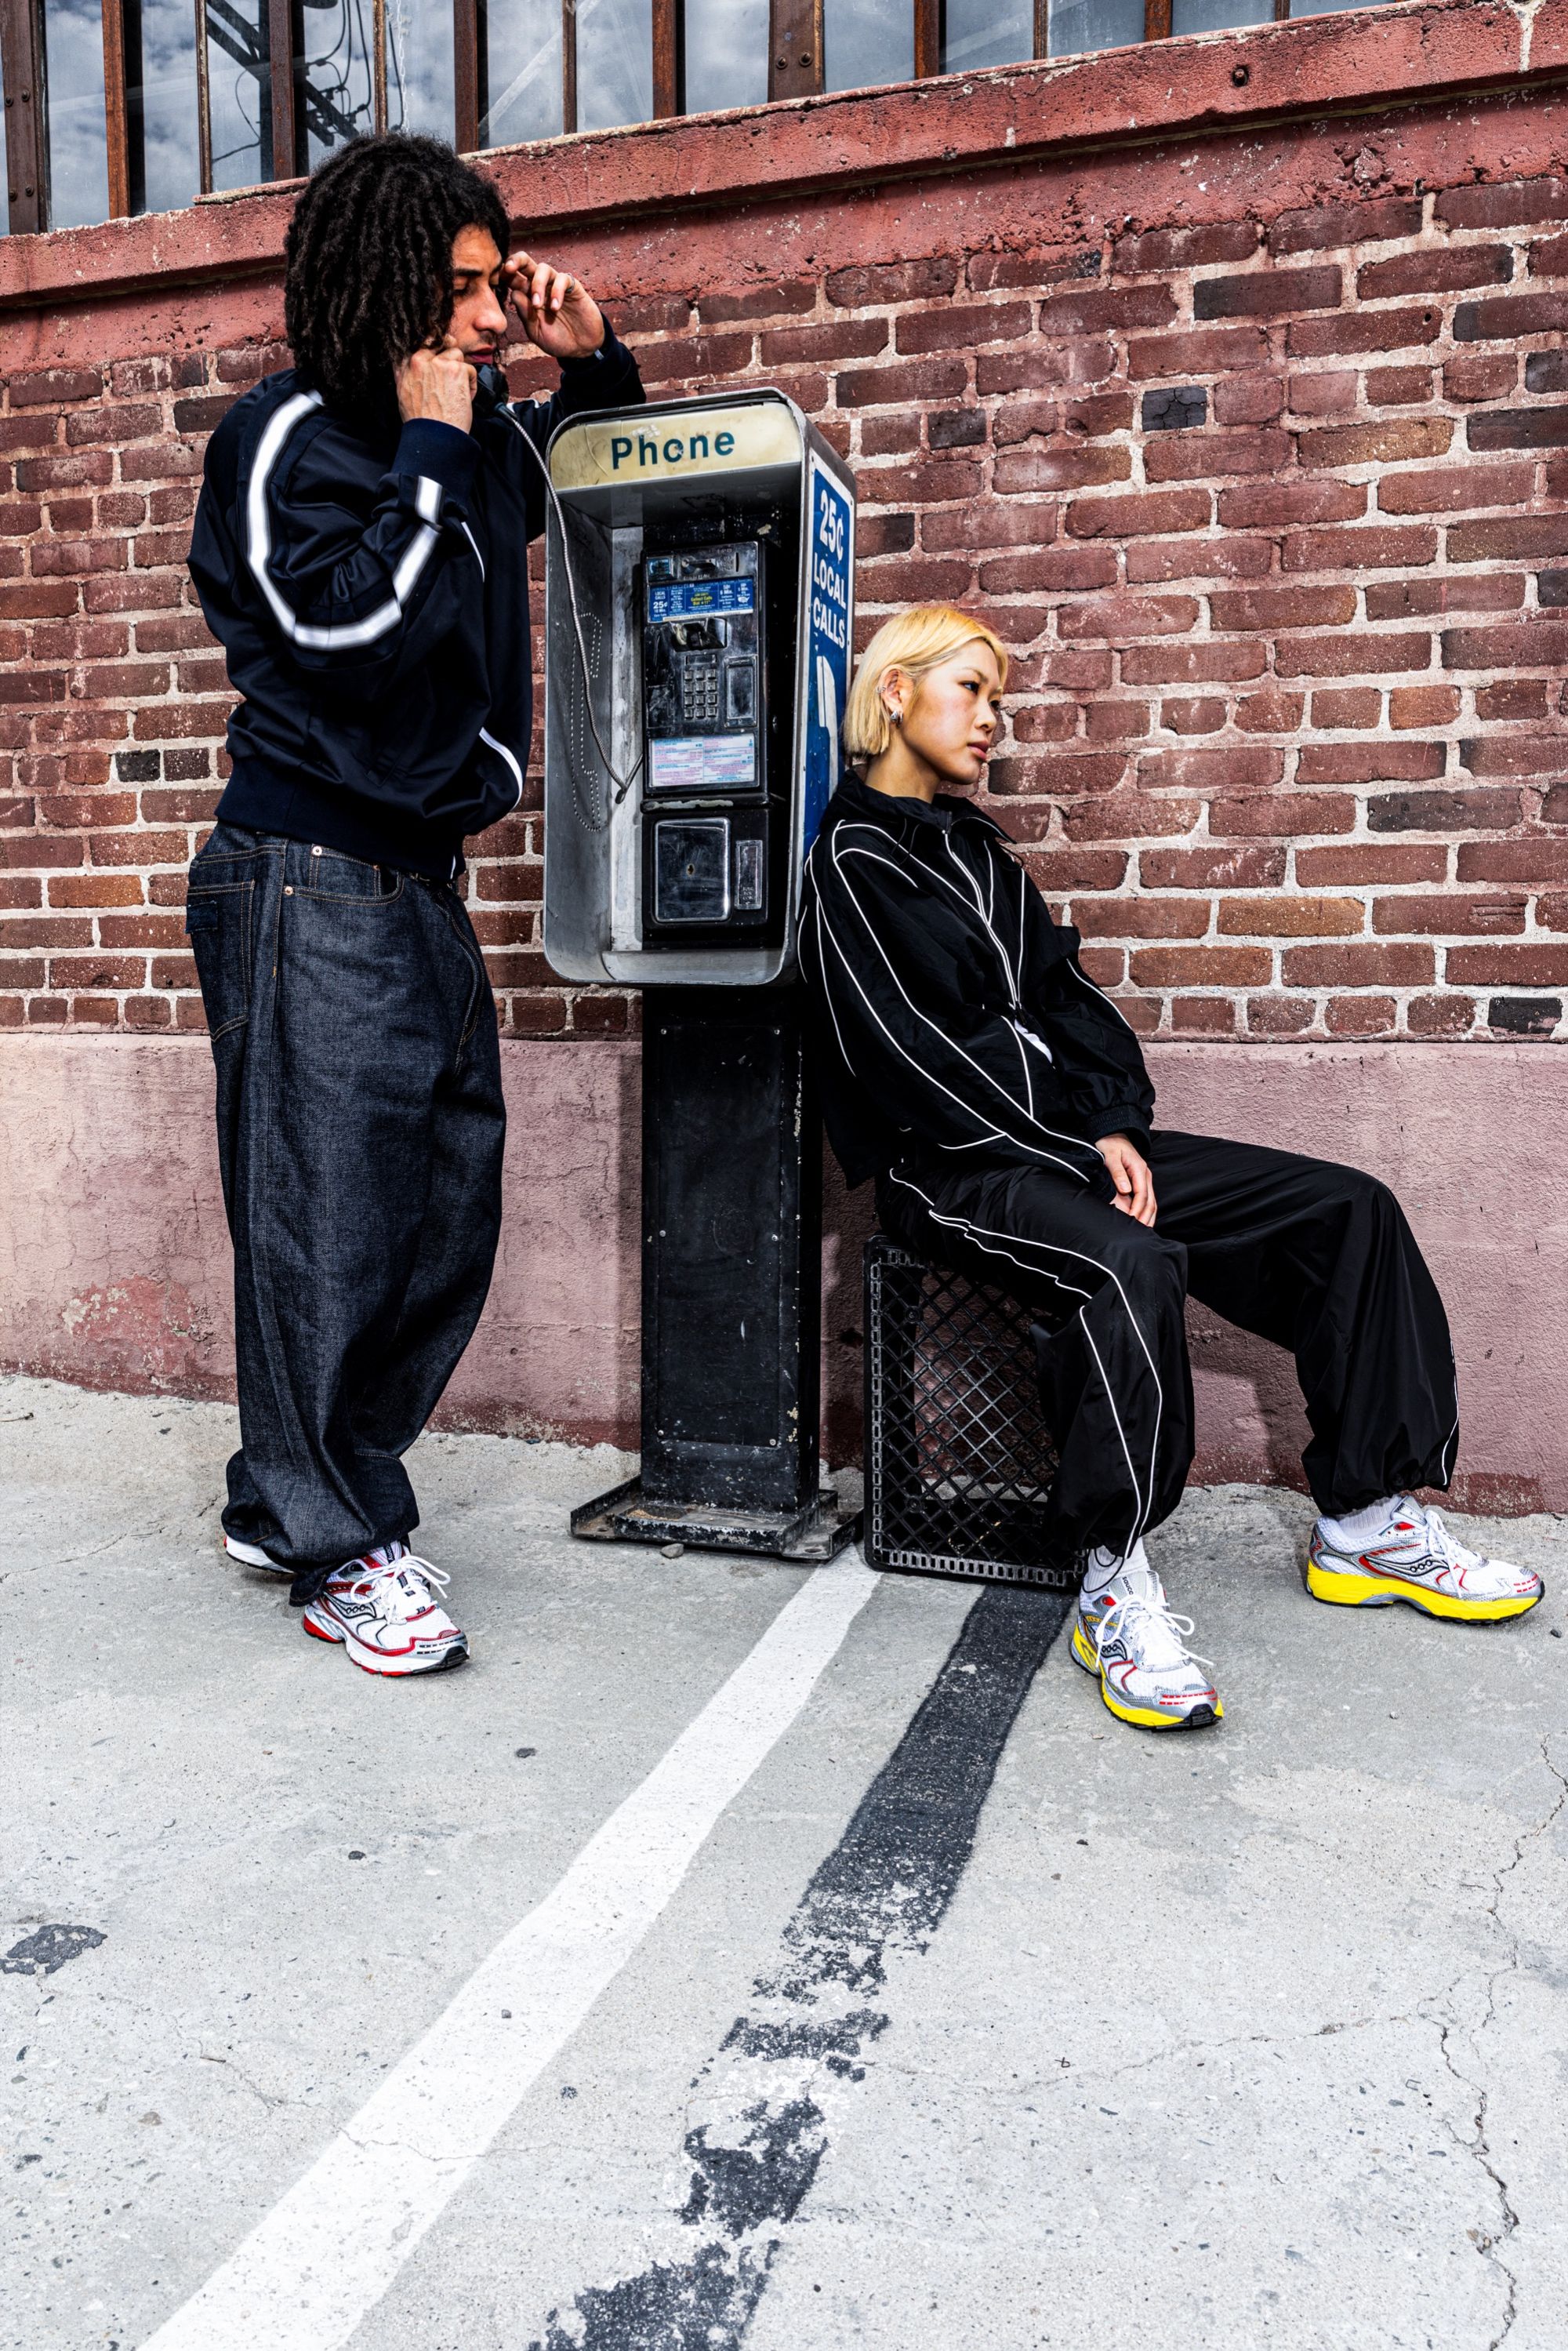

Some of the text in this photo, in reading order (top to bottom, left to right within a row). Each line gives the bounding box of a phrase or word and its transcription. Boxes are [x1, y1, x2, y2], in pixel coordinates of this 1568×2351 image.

[612, 431, 735, 470] Phone
[819, 489, 844, 565] 25¢
[814, 552, 846, 610] LOCAL
[653, 601, 668, 609] 25¢
[813, 597, 845, 649] CALLS
[1122, 1576, 1134, 1596] sauco
